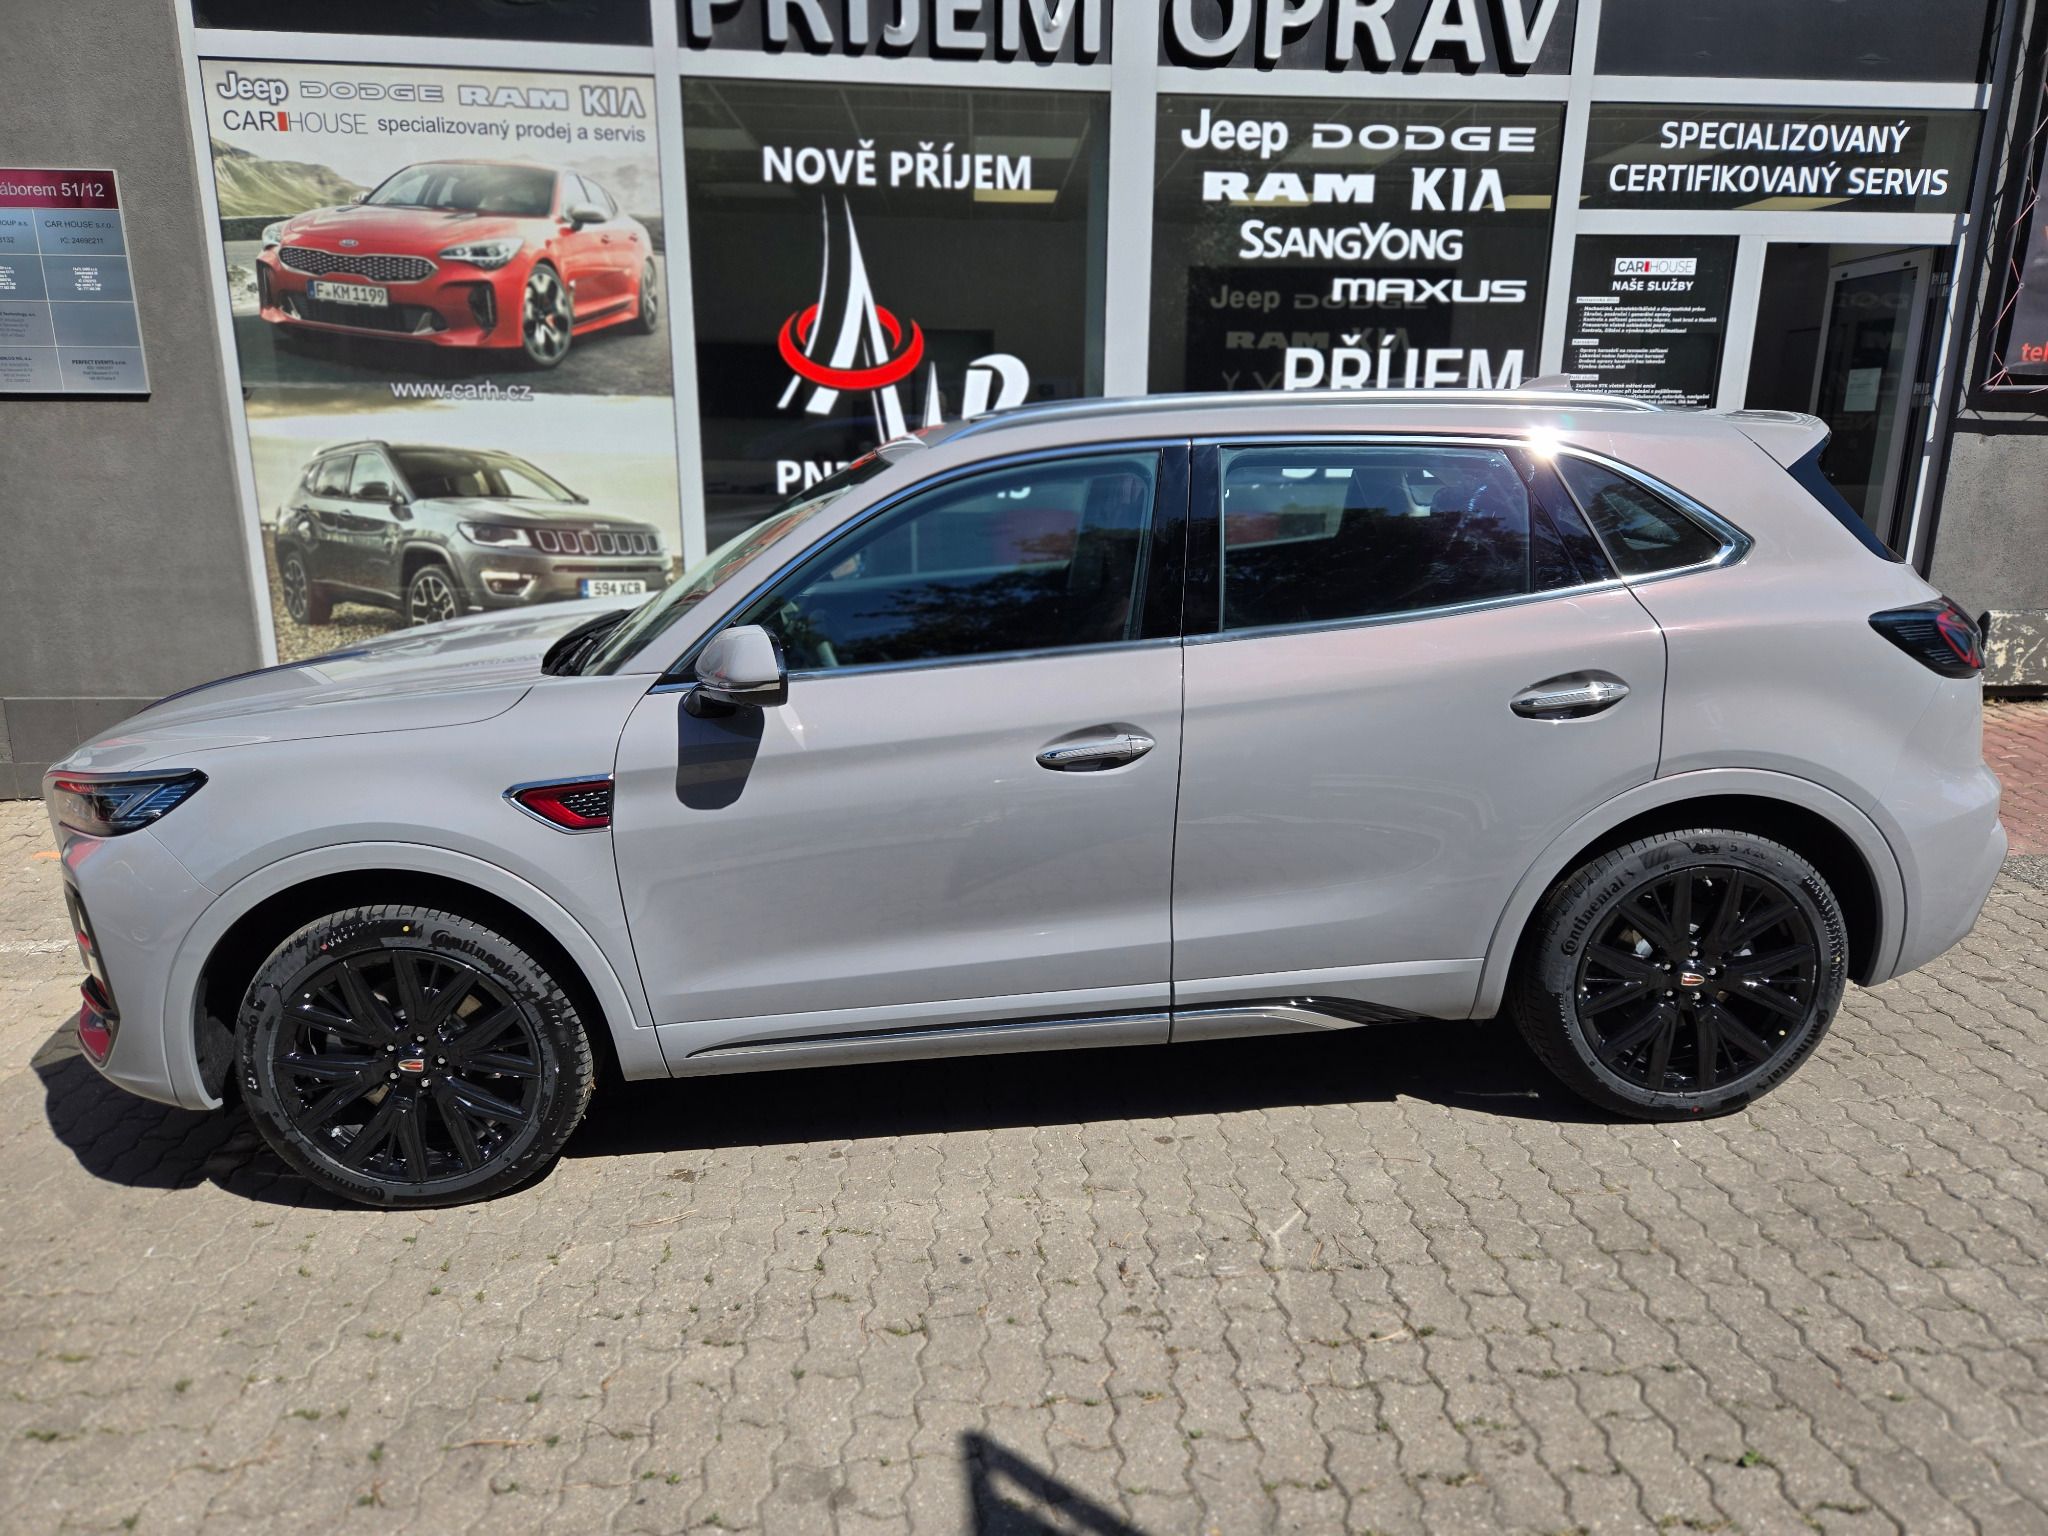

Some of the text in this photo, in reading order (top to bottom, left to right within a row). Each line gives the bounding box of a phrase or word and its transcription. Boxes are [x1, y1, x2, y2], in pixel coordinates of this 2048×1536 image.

[1172, 0, 1560, 63] OPRAV
[217, 71, 646, 118] Jeep DODGE RAM KIA
[223, 110, 645, 143] CAR HOUSE specializovaný prodej a servis
[1181, 108, 1536, 159] Jeep DODGE
[1660, 120, 1910, 153] SPECIALIZOVANÝ
[762, 139, 1032, 190] NOVĚ PŘÍJEM
[1609, 162, 1949, 196] CERTIFIKOVANÝ SERVIS
[61, 182, 105, 198] 51/12
[1203, 167, 1506, 211] RAM KIA
[45, 220, 62, 229] CAR
[65, 221, 93, 229] HOUSE
[1617, 260, 1693, 273] CAR HOUSE
[1210, 285, 1280, 313] Jeep
[1332, 278, 1527, 303] MAXUS
[1612, 278, 1694, 292] NAŠE SLUŽBY
[1226, 331, 1329, 349] RAM
[390, 380, 533, 401] www.carh.cz
[1561, 876, 1626, 956] Continental
